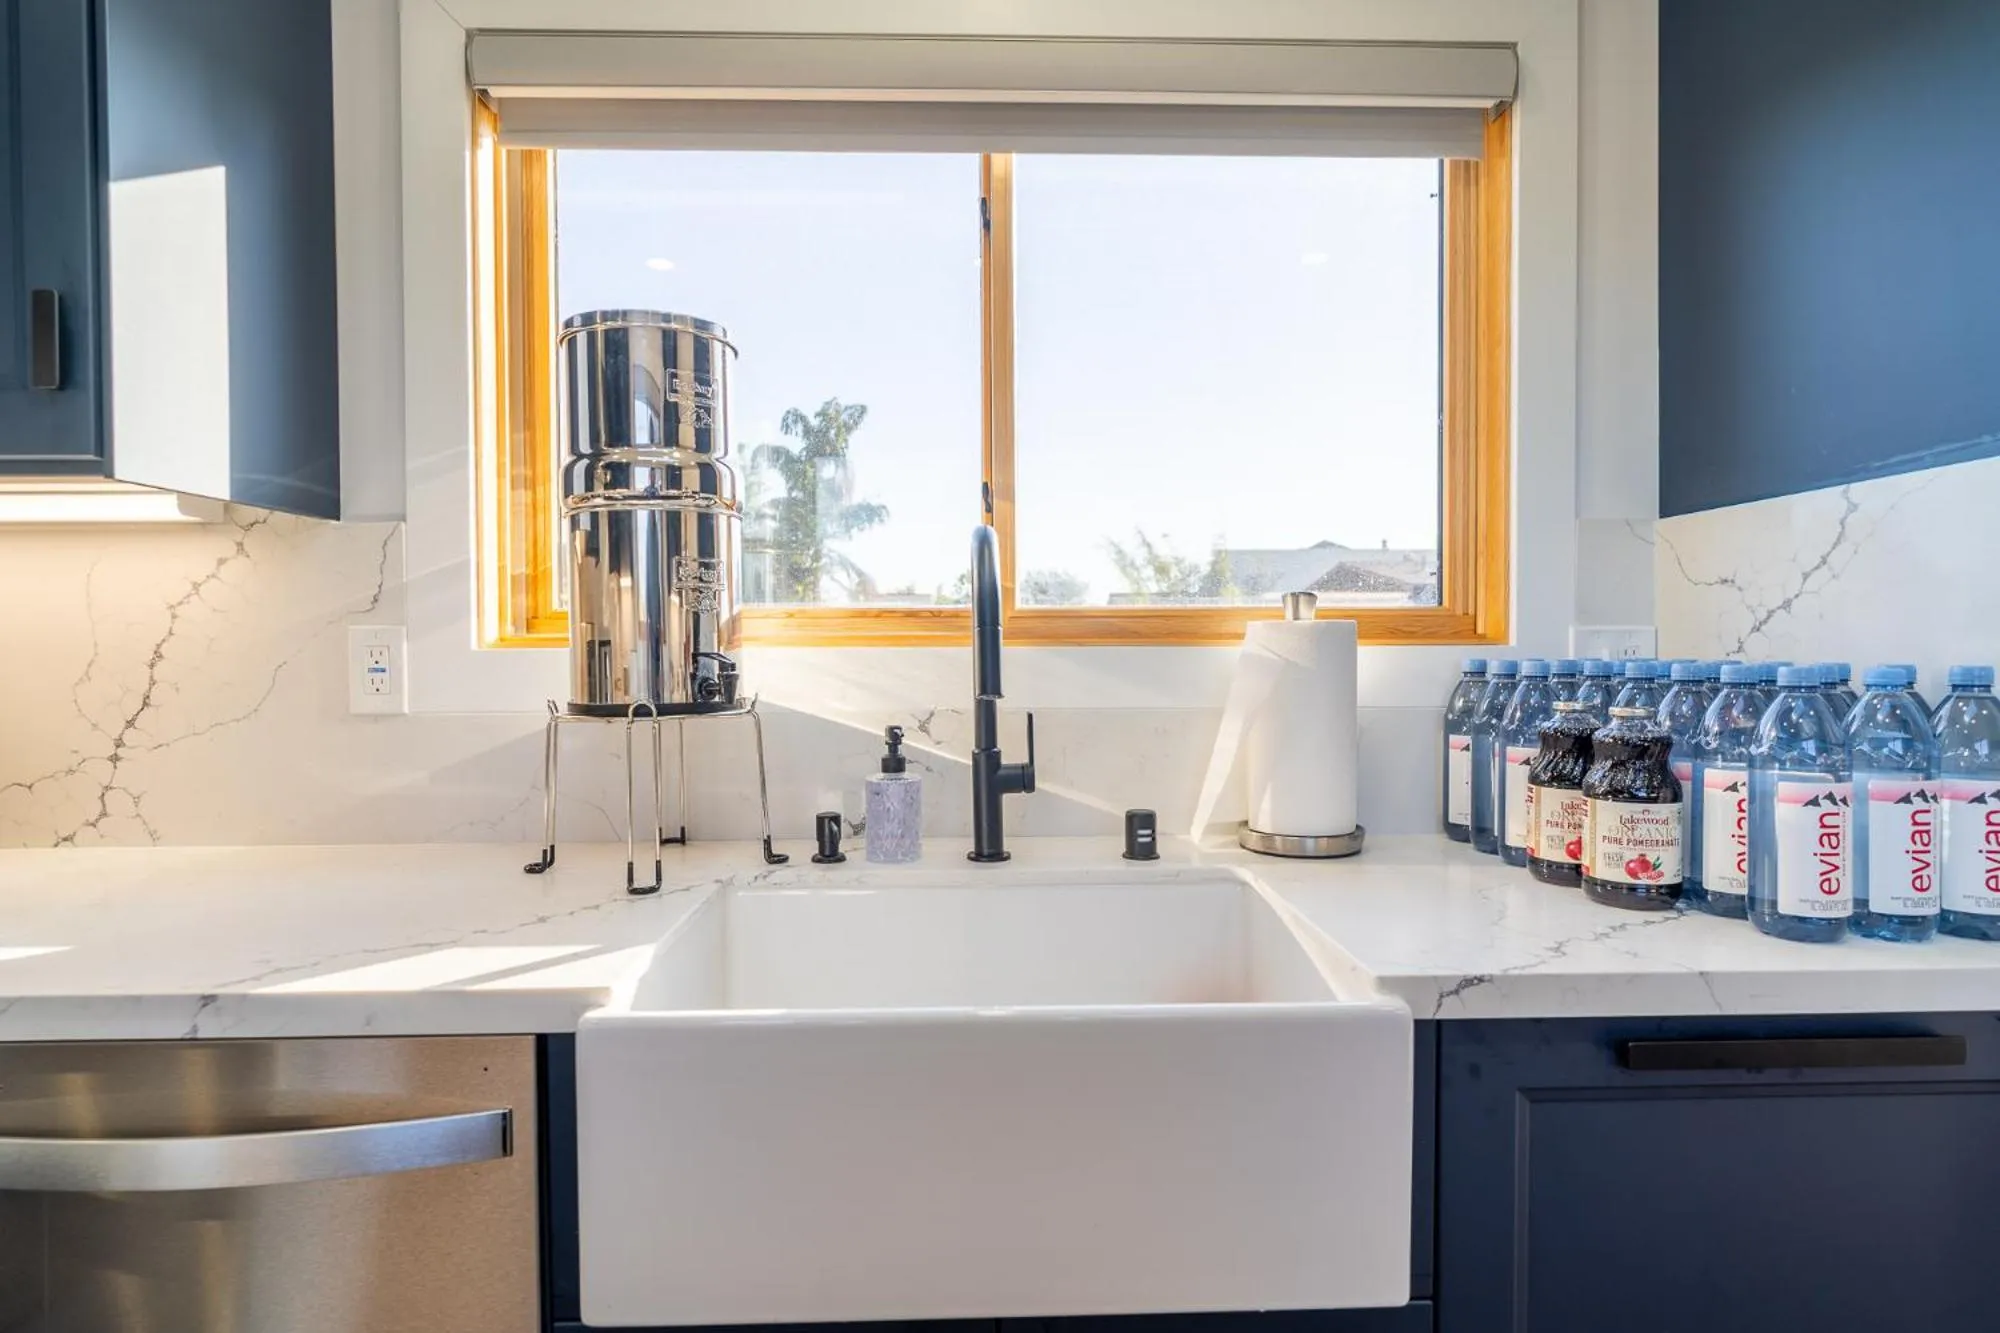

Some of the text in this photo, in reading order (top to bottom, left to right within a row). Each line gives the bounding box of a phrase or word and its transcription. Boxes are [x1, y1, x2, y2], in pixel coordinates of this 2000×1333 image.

[1602, 835, 1624, 846] PURE
[1619, 815, 1669, 828] Lakewood
[1813, 811, 1841, 896] evian
[1905, 809, 1932, 893] evian
[1978, 809, 2000, 893] evian
